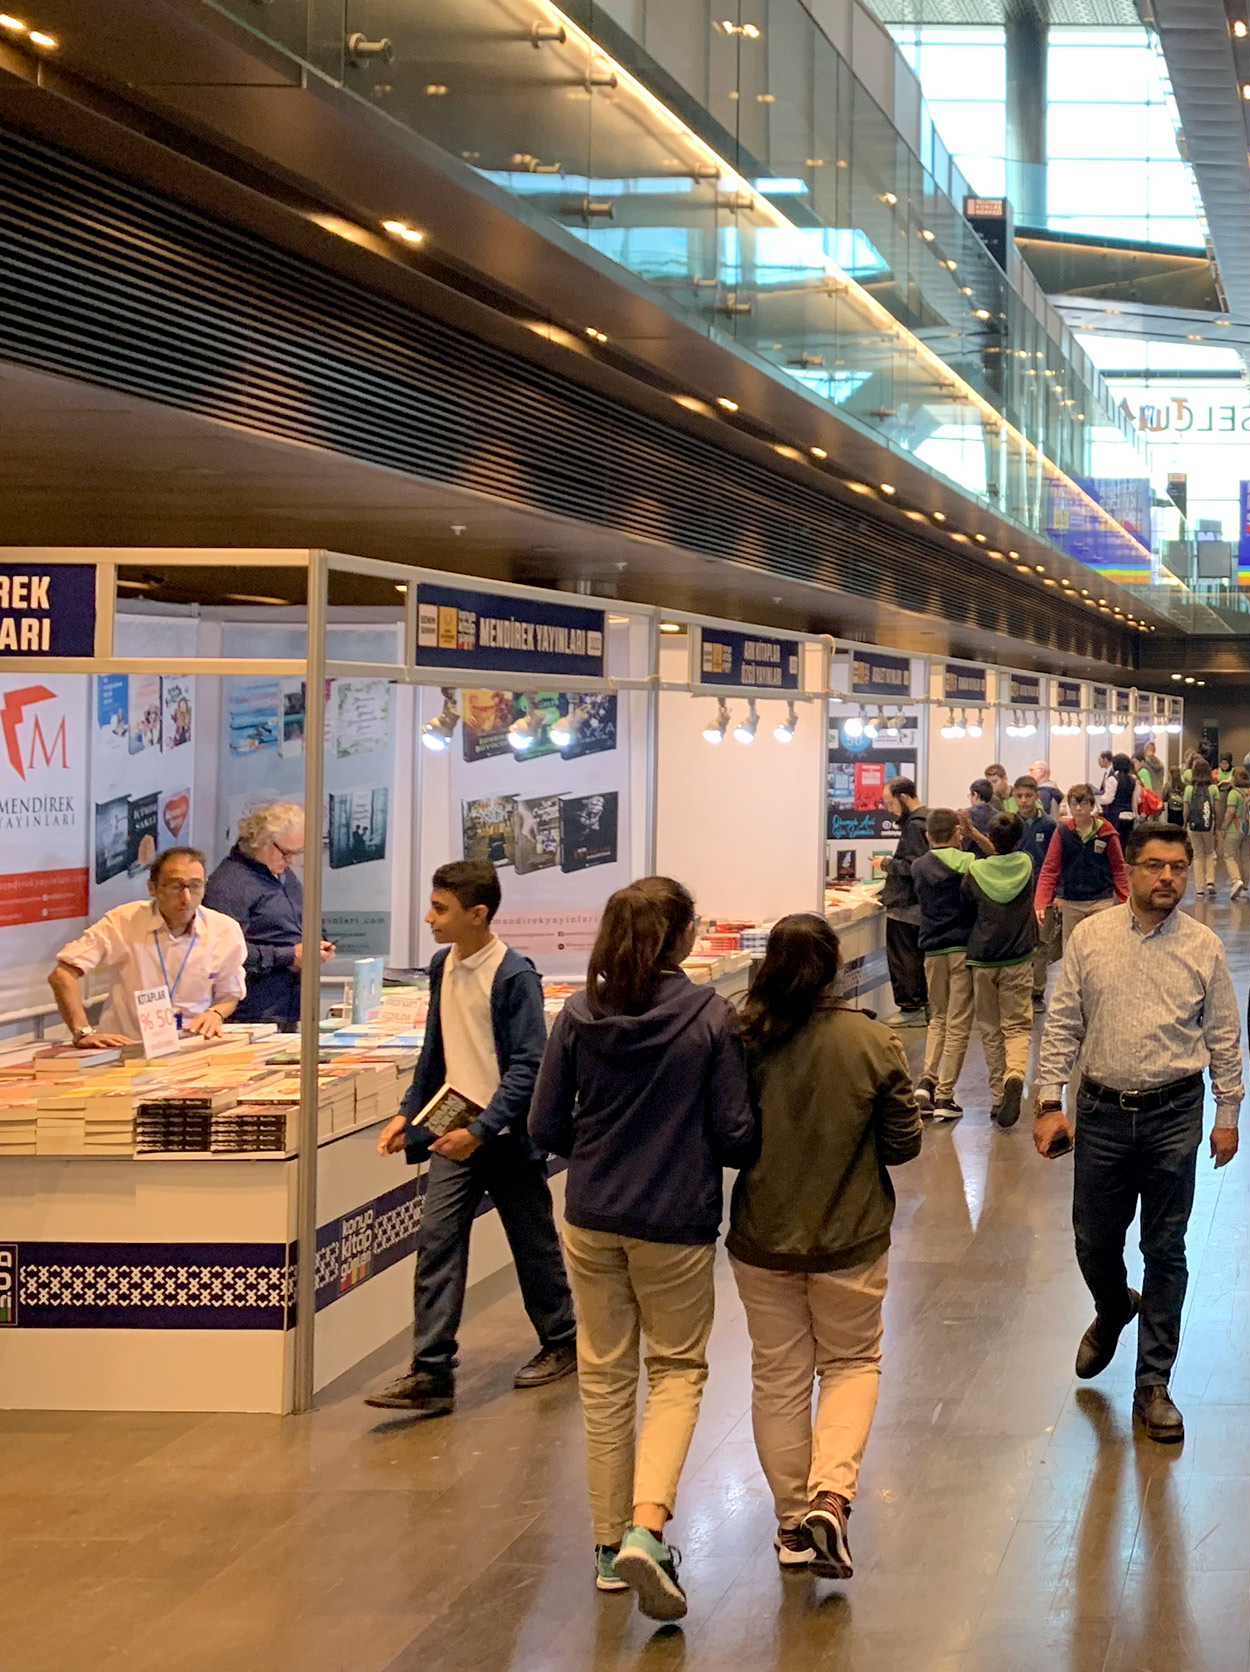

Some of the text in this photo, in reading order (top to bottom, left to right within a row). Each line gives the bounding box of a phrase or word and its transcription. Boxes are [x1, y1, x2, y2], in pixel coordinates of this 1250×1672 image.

[479, 616, 535, 651] MENDİREK
[535, 624, 586, 655] YAYINLARI
[0, 794, 75, 815] MENDİREK
[156, 1008, 174, 1028] 50
[342, 1209, 373, 1238] konya
[341, 1229, 373, 1261] kitap
